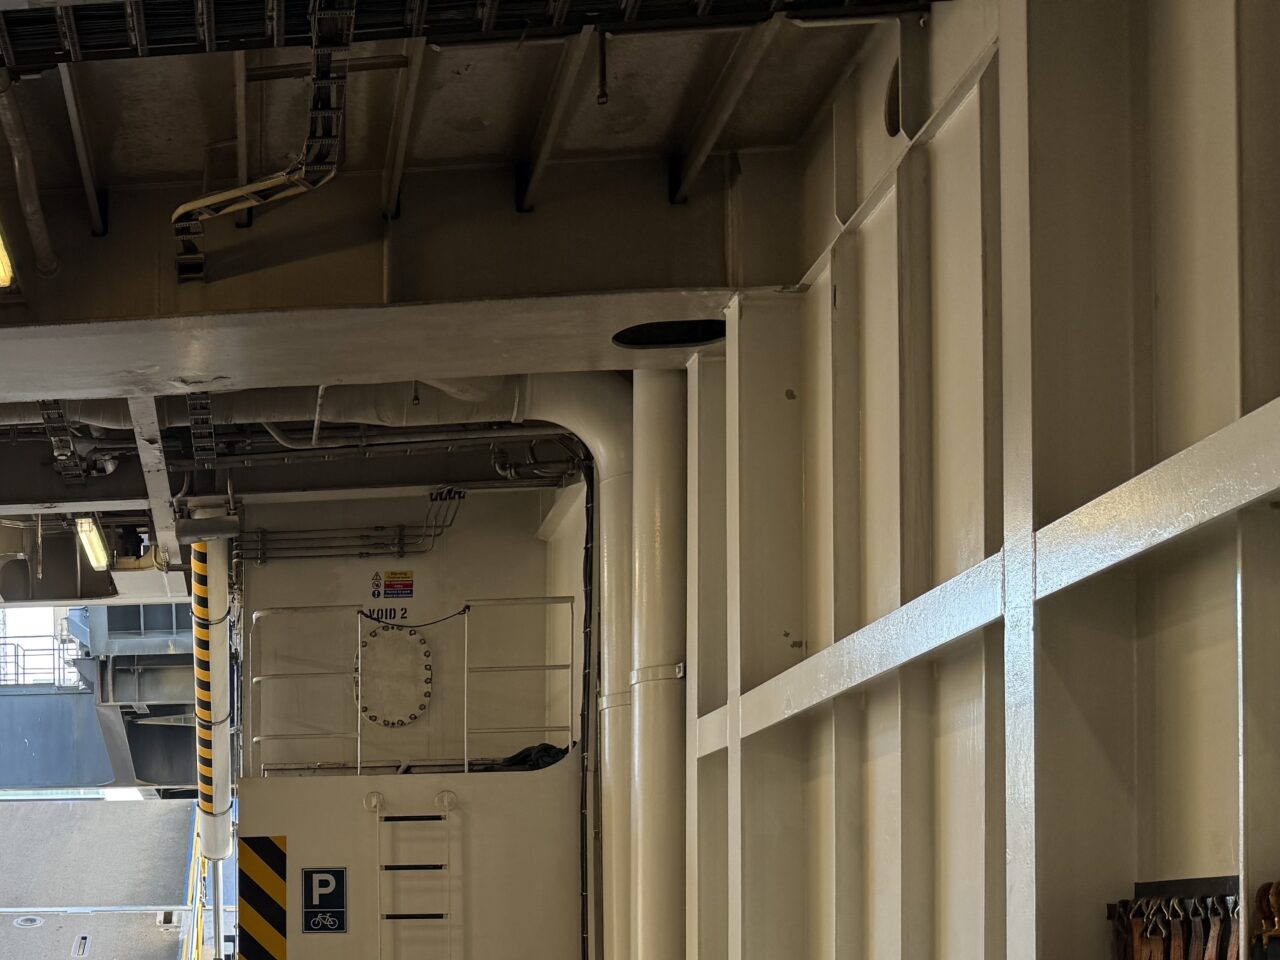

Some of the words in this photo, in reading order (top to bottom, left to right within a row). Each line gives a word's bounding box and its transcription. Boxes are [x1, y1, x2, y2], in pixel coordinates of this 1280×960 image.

[368, 608, 396, 620] VOID
[400, 607, 408, 619] 2
[312, 873, 336, 905] P
